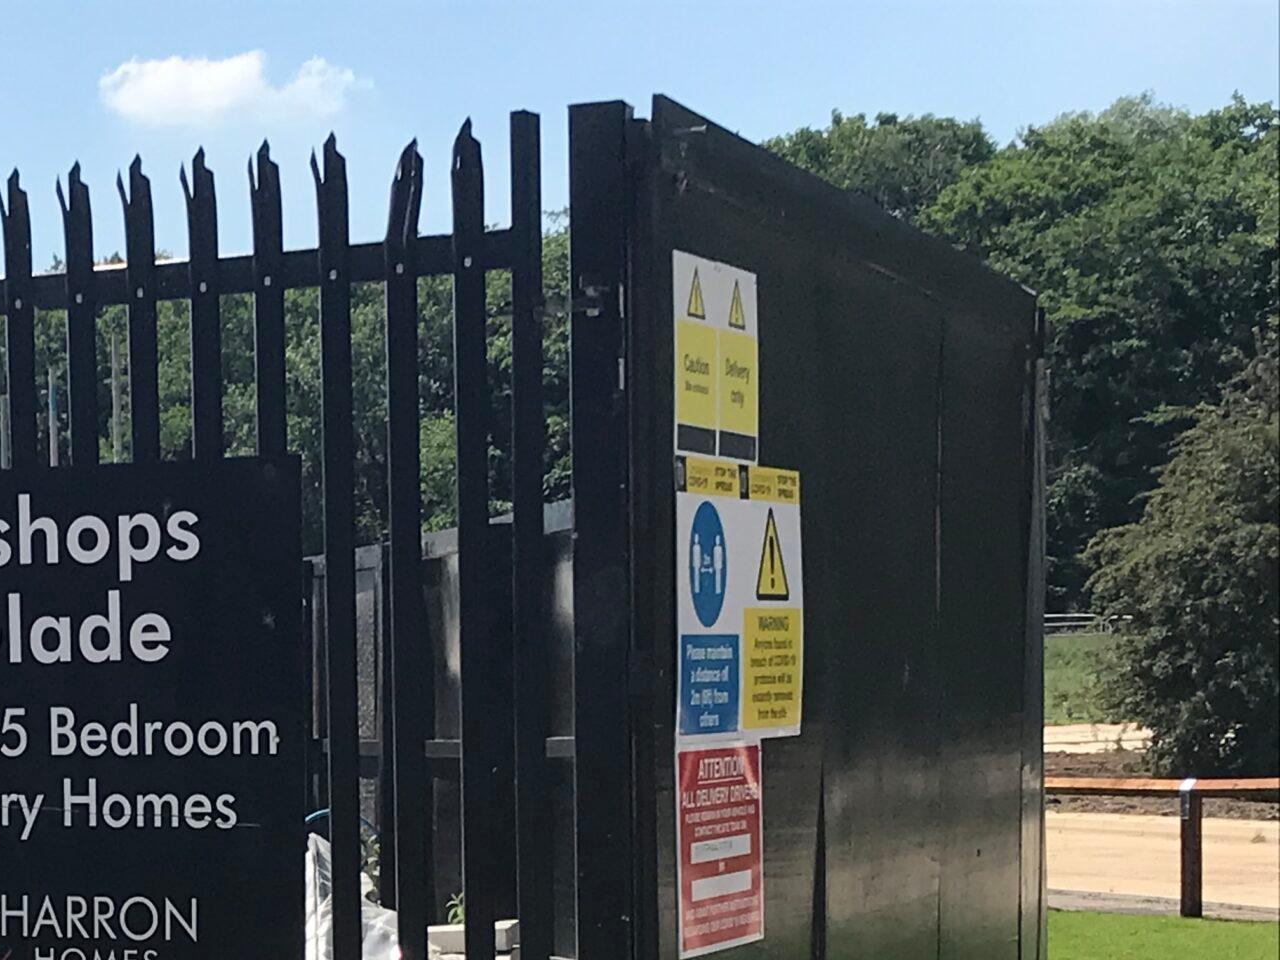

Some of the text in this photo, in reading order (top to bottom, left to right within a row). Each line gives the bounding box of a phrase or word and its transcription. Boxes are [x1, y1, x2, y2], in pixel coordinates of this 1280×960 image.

[1, 708, 28, 757] 5
[51, 703, 278, 756] Bedroom
[698, 755, 745, 780] ATTENTION
[64, 778, 238, 829] Homes
[682, 791, 695, 810] ALL
[696, 786, 729, 808] DELIVERY
[1, 894, 198, 942] HARRON
